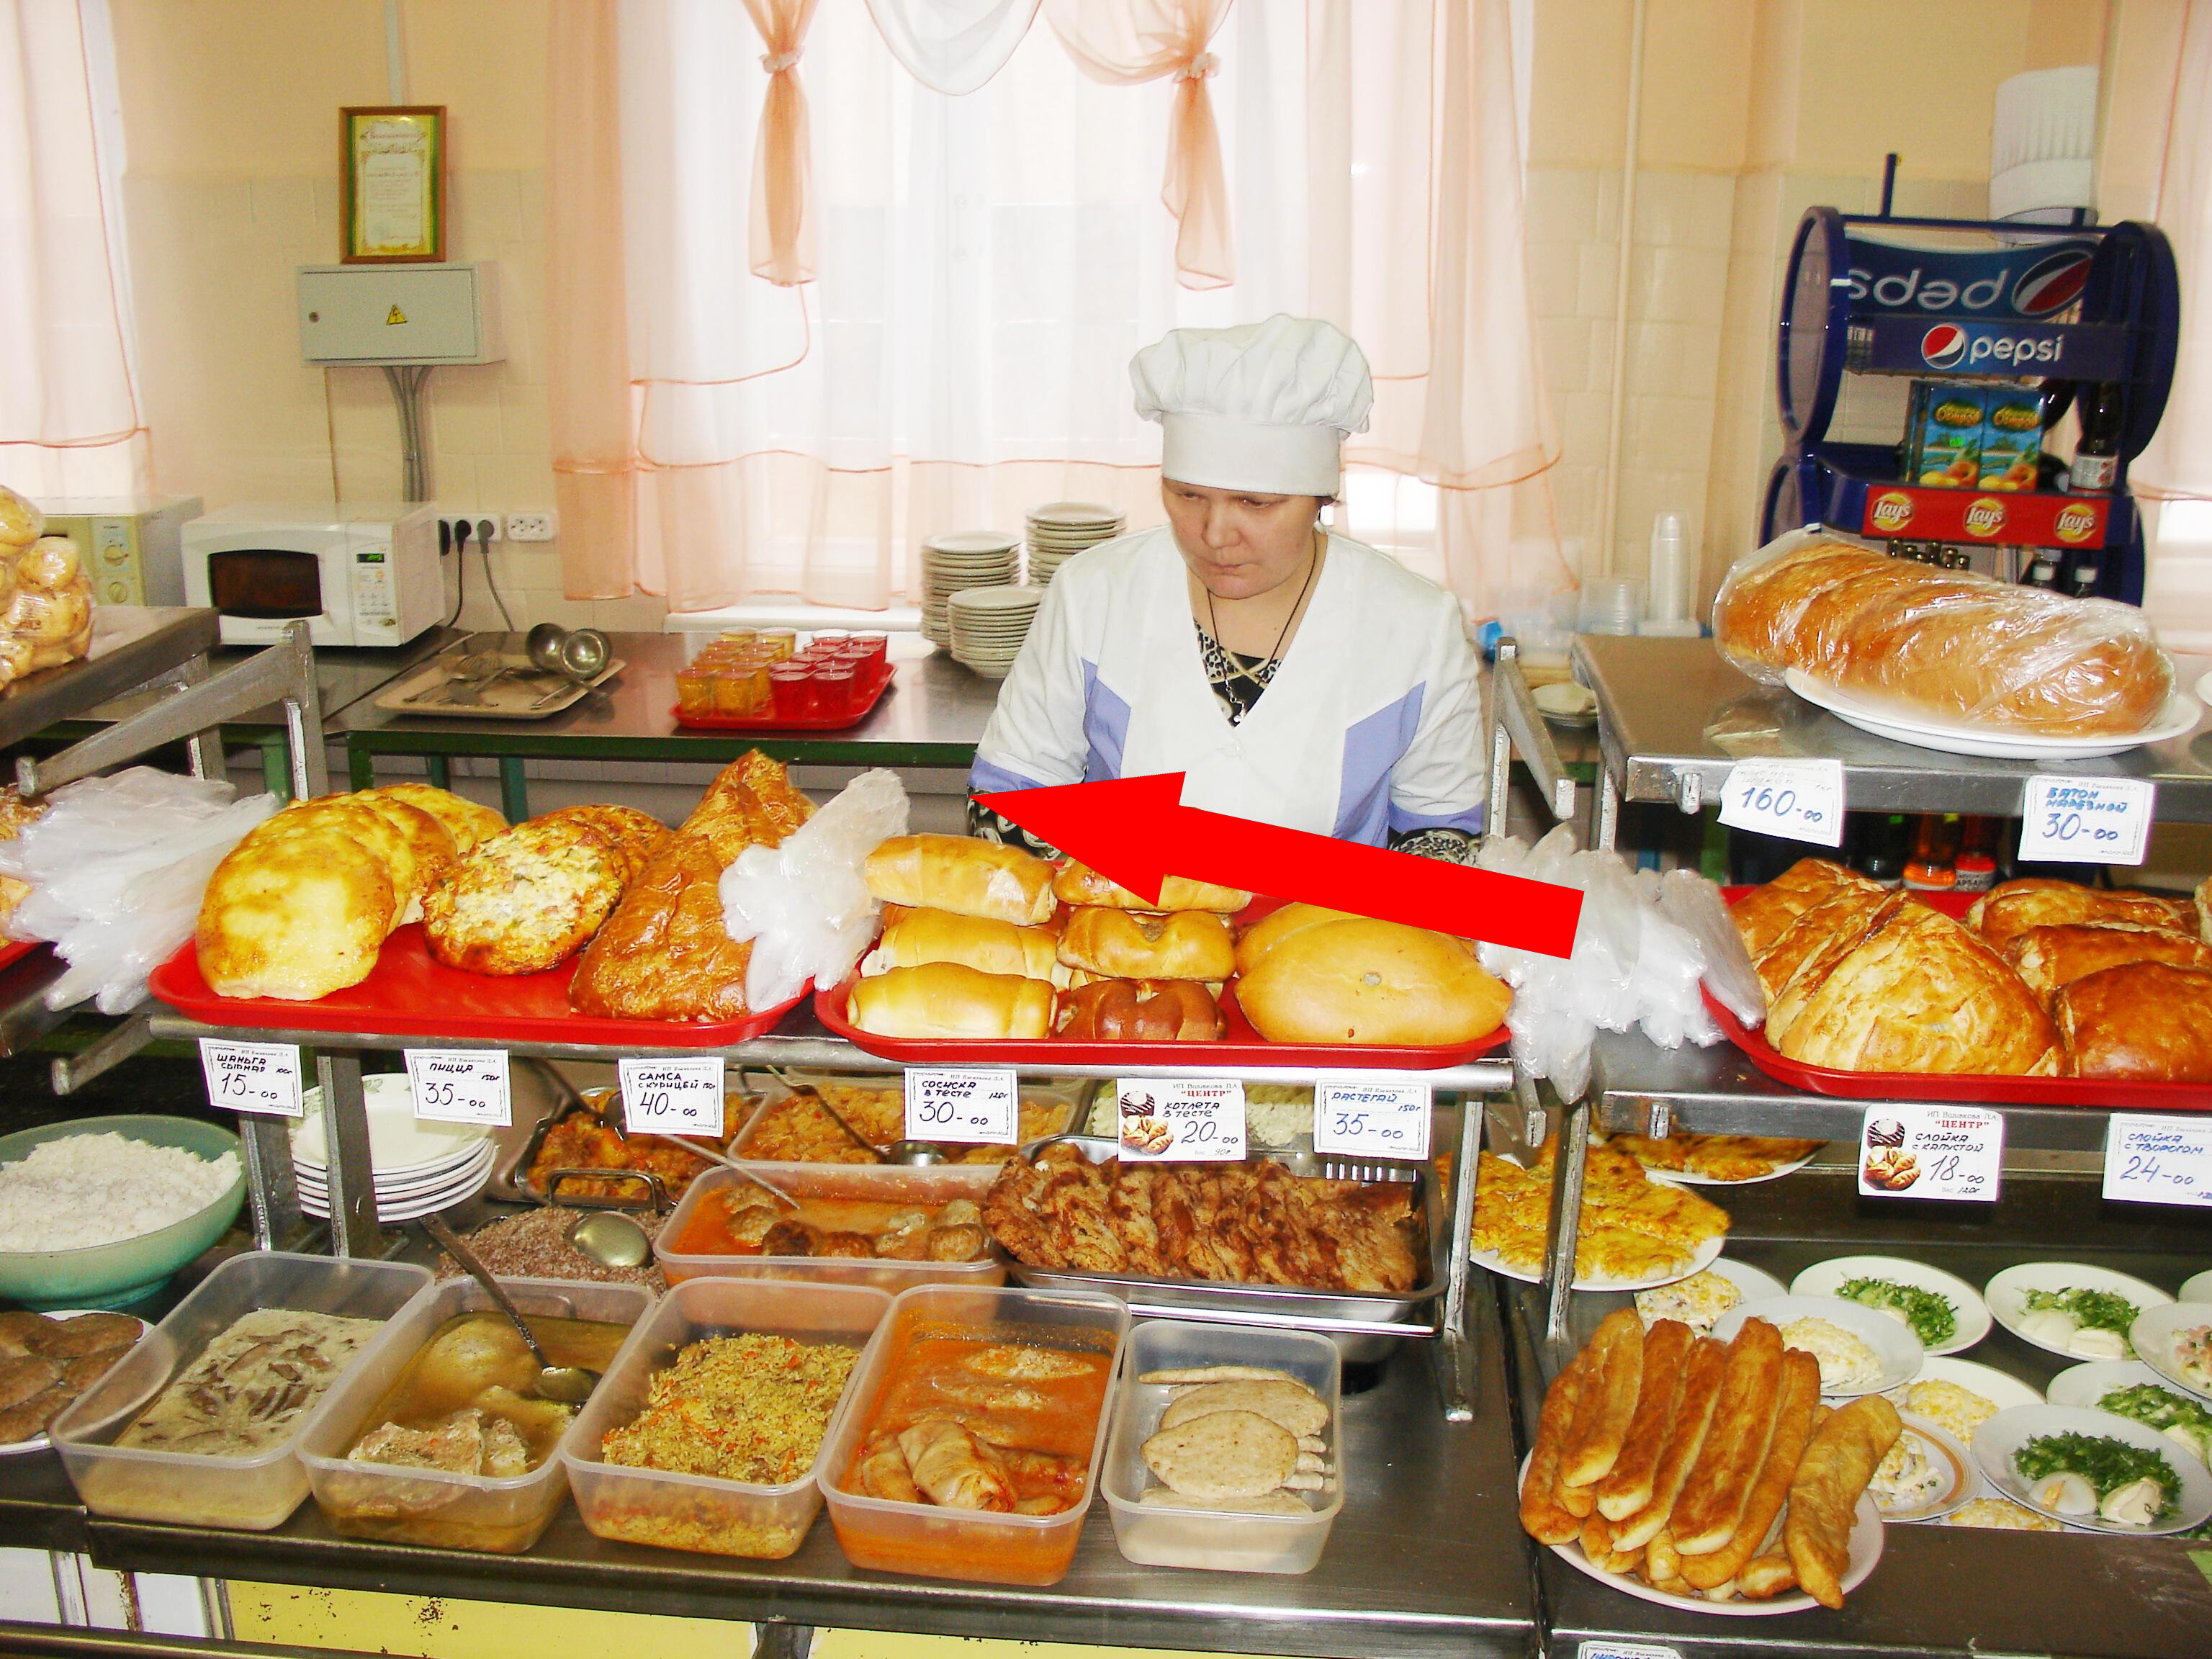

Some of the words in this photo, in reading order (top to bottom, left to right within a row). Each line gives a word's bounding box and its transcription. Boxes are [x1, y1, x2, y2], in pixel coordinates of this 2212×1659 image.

[1848, 267, 2009, 310] peps
[1969, 334, 2064, 367] pepsi
[2046, 787, 2099, 799] БАТОН
[2045, 799, 2128, 813] НАРЕЗНОЙ
[217, 1053, 266, 1065] ШАНЬГА
[221, 1063, 266, 1073] СЫРНАЯ
[429, 1063, 473, 1074] ПИЦЦА
[639, 1072, 682, 1081] САМСА
[647, 1079, 698, 1091] КУРИЦЕЙ
[922, 1080, 976, 1089] СОСИСКА
[1331, 1092, 1398, 1102] РАСТЕГАЙ
[1915, 1132, 1969, 1142] СЛОЙКА
[2128, 1133, 2183, 1143] СЛОЙКА
[1922, 1143, 1984, 1153] КАПУСТОЙ
[2136, 1143, 2203, 1154] ТВОРОГОМ
